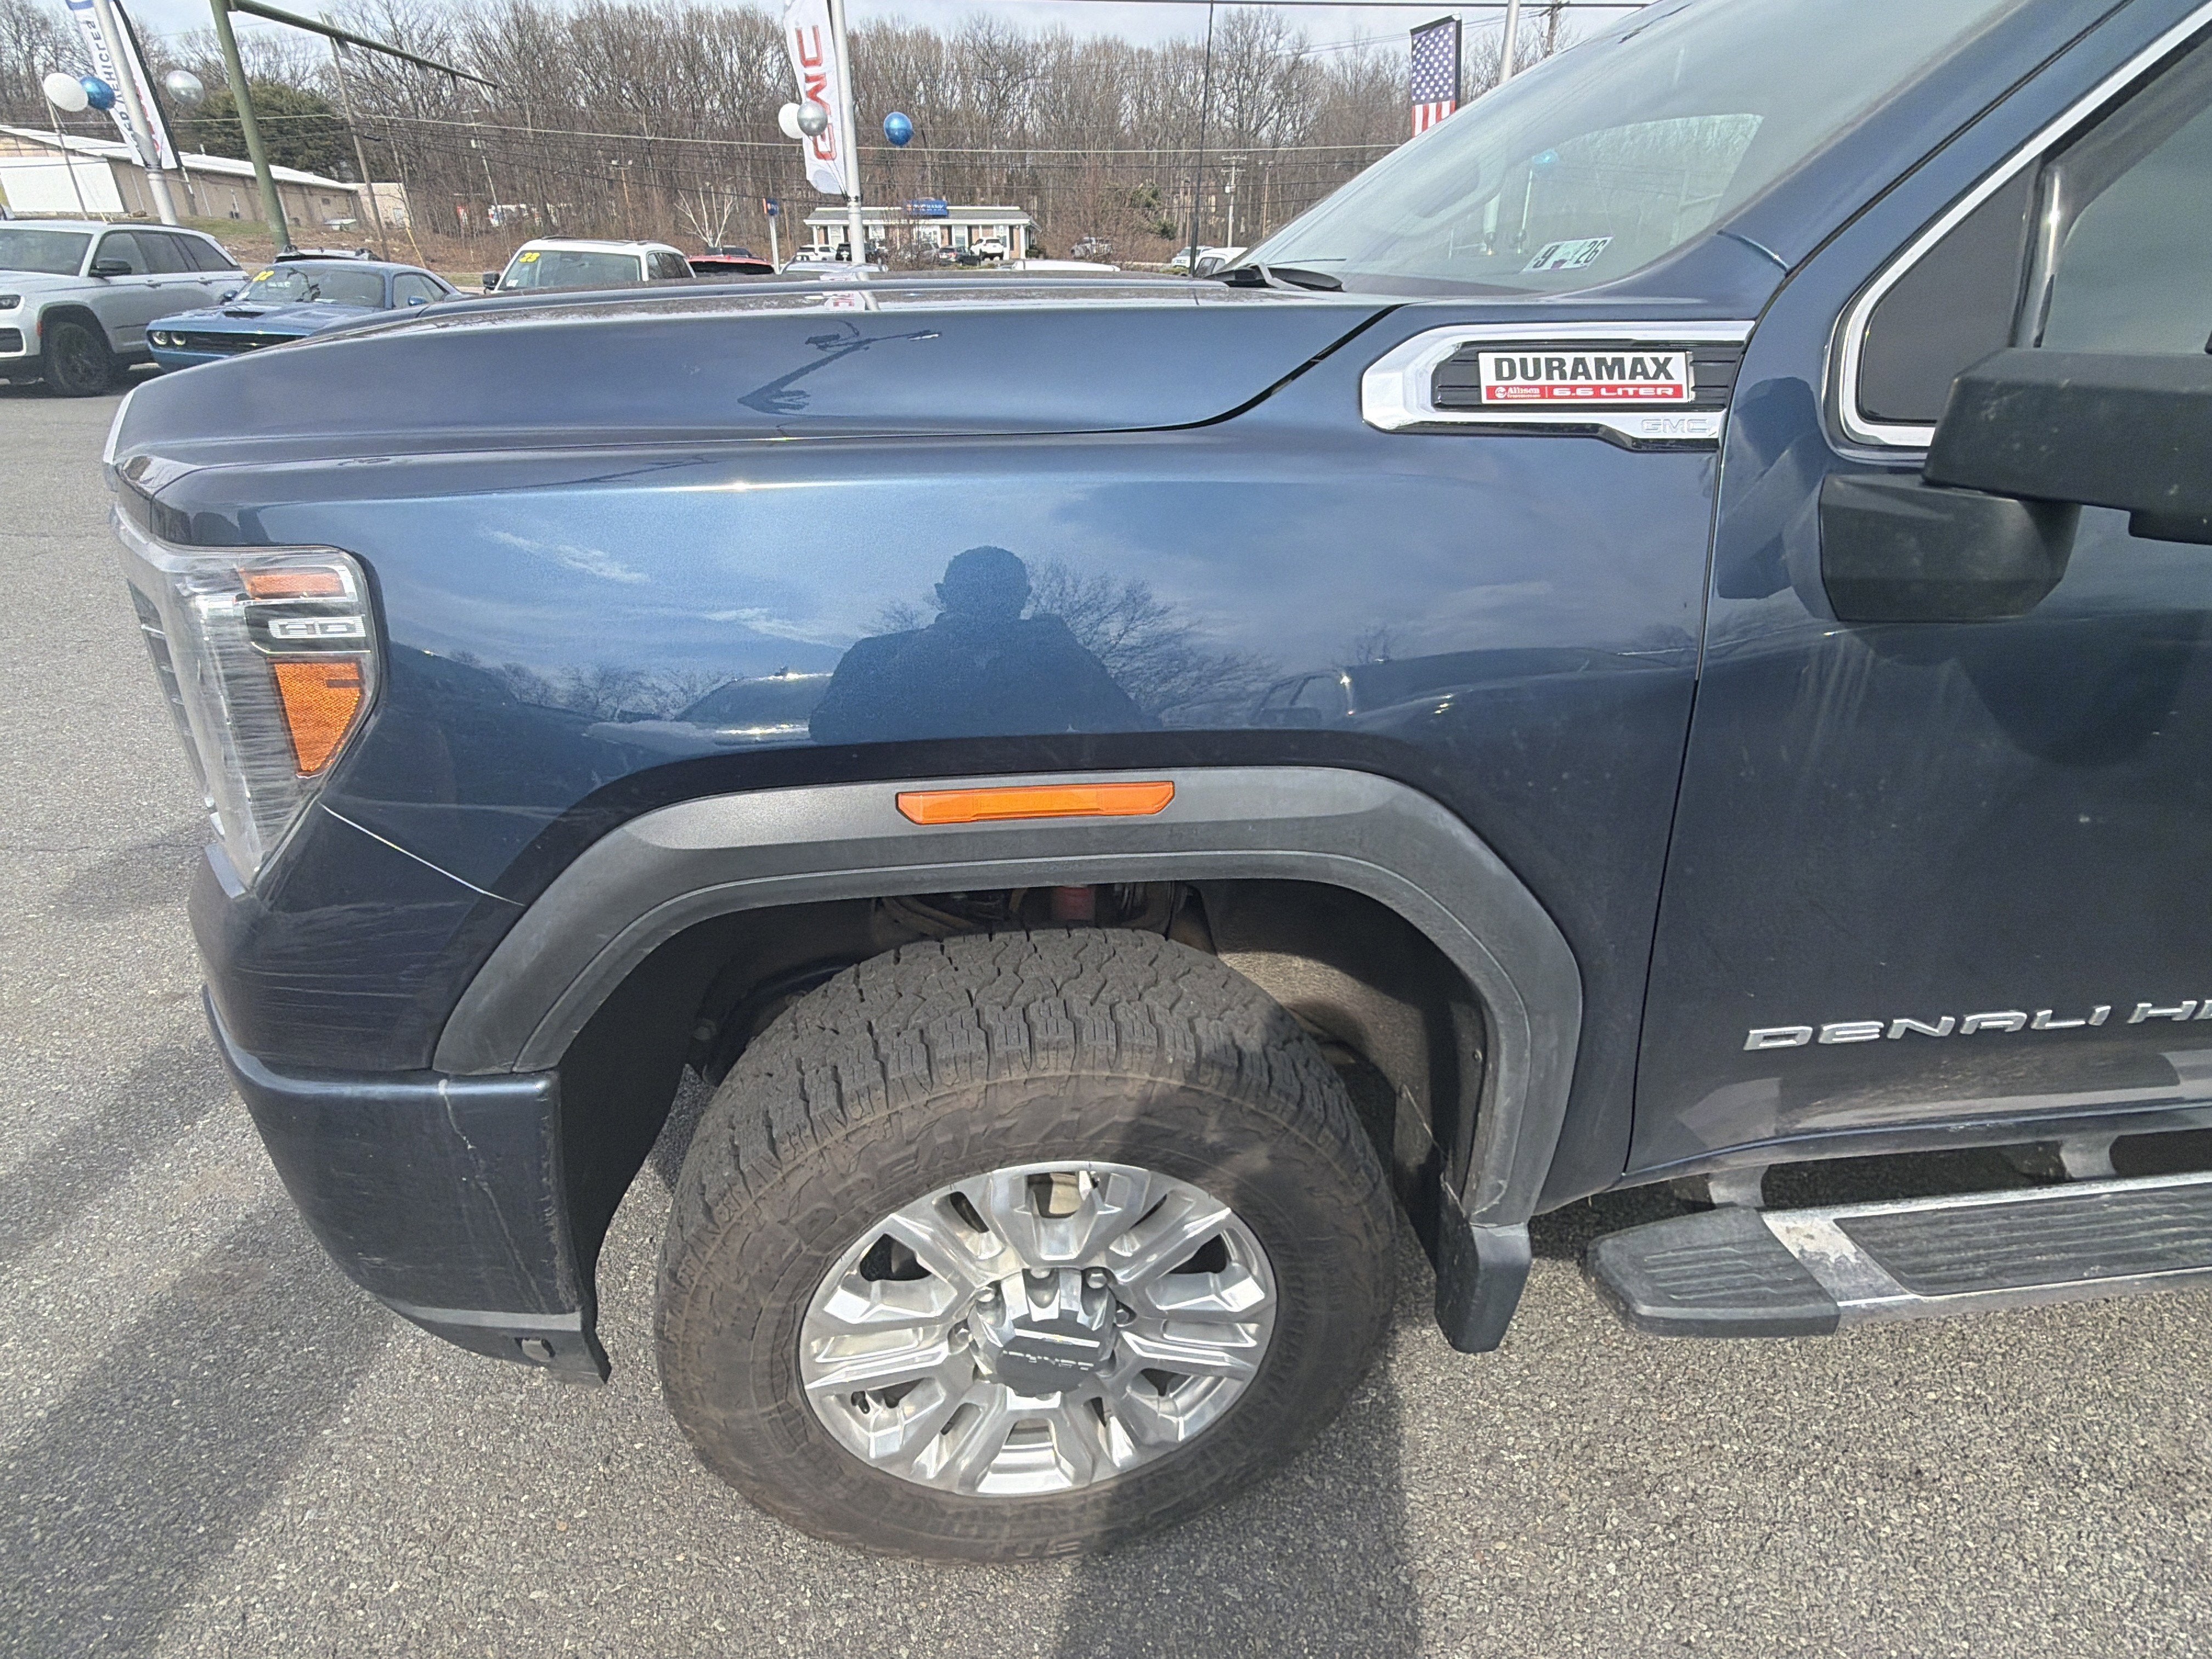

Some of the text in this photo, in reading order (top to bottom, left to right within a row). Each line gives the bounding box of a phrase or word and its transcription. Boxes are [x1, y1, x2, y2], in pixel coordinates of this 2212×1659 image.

[1494, 357, 1675, 381] DURAMAX
[1553, 387, 1674, 396] 6.6 LITER
[1641, 419, 1709, 433] GMC
[1743, 999, 2212, 1051] DENALI H
